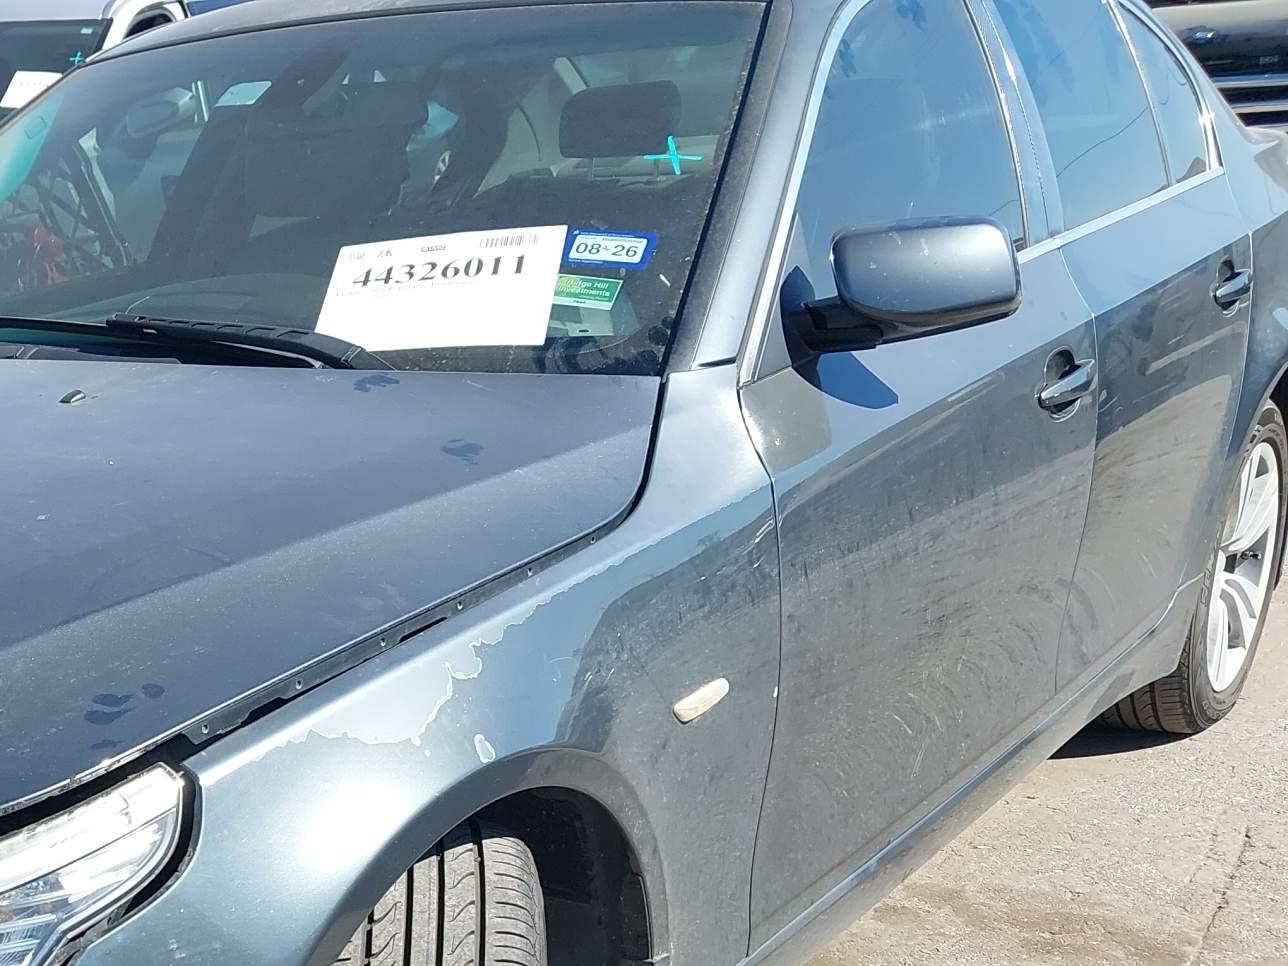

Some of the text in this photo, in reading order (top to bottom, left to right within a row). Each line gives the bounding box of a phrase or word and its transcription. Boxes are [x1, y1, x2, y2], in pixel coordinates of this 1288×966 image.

[575, 242, 639, 258] 08 26
[352, 254, 526, 287] 44326011
[593, 281, 609, 289] Hill
